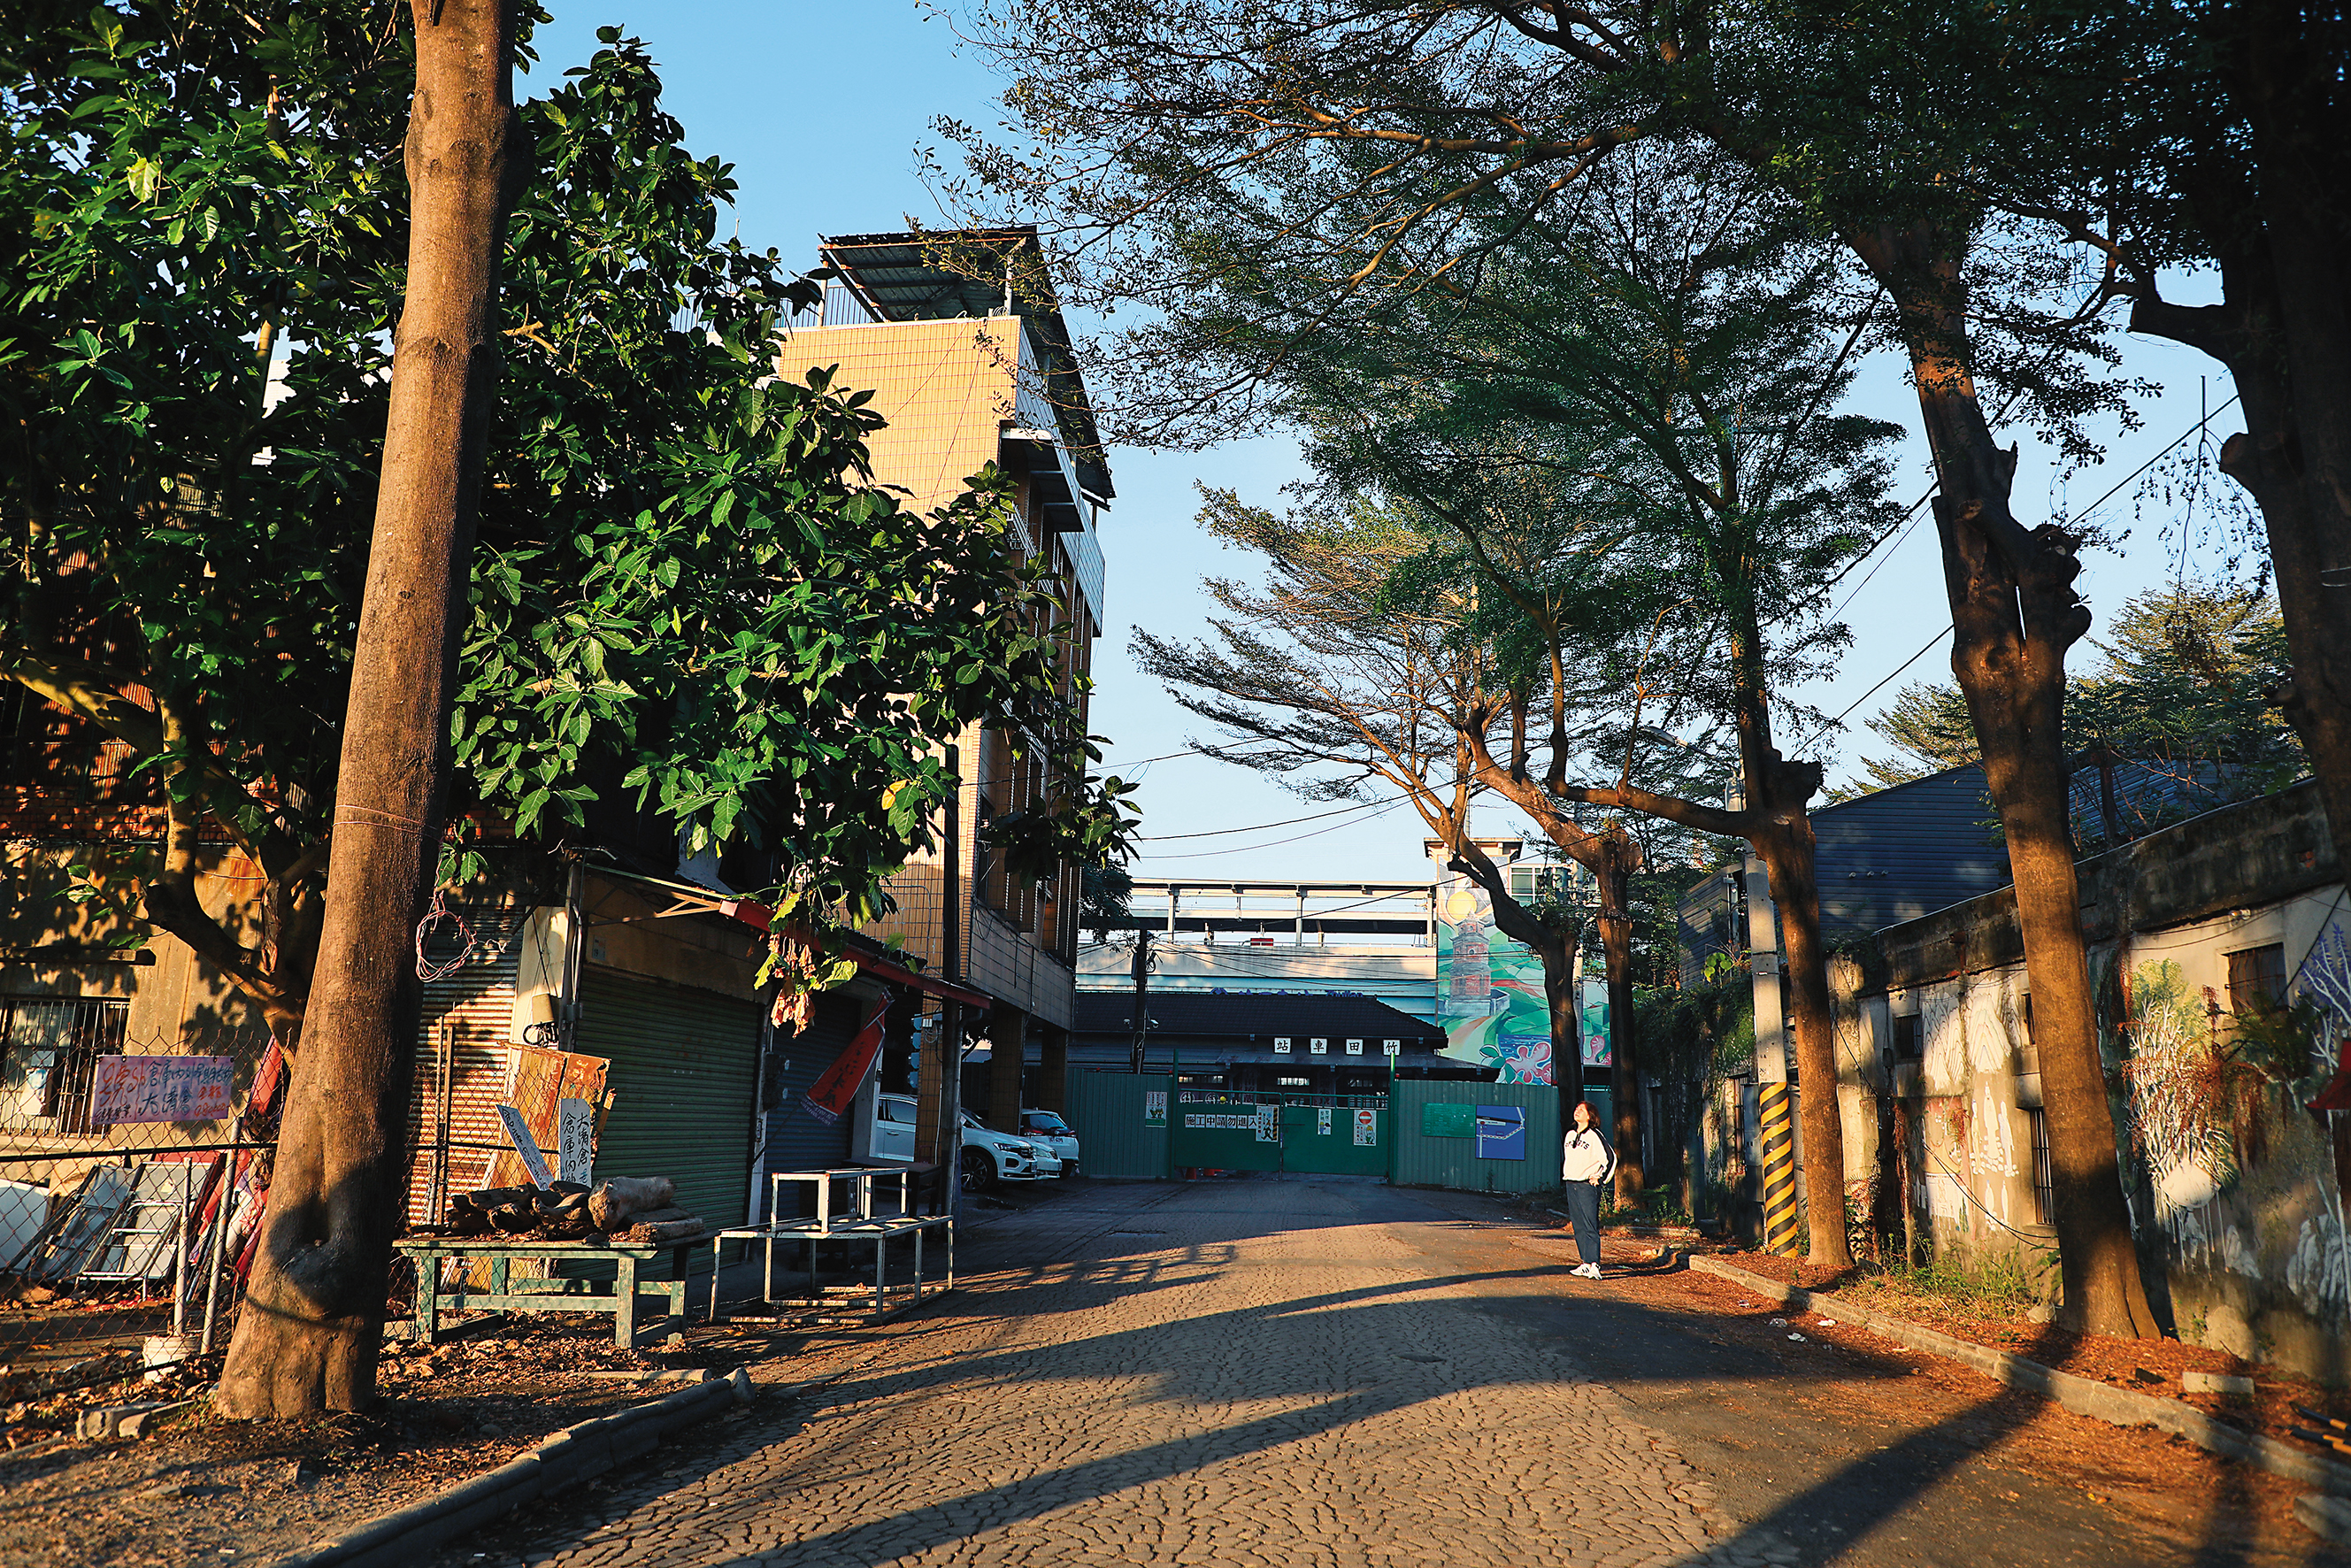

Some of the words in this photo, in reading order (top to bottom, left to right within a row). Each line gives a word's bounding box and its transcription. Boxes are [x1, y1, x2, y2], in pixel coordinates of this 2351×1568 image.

[1186, 1116, 1257, 1127] 施工中請勿進入
[577, 1112, 589, 1166] 大清倉
